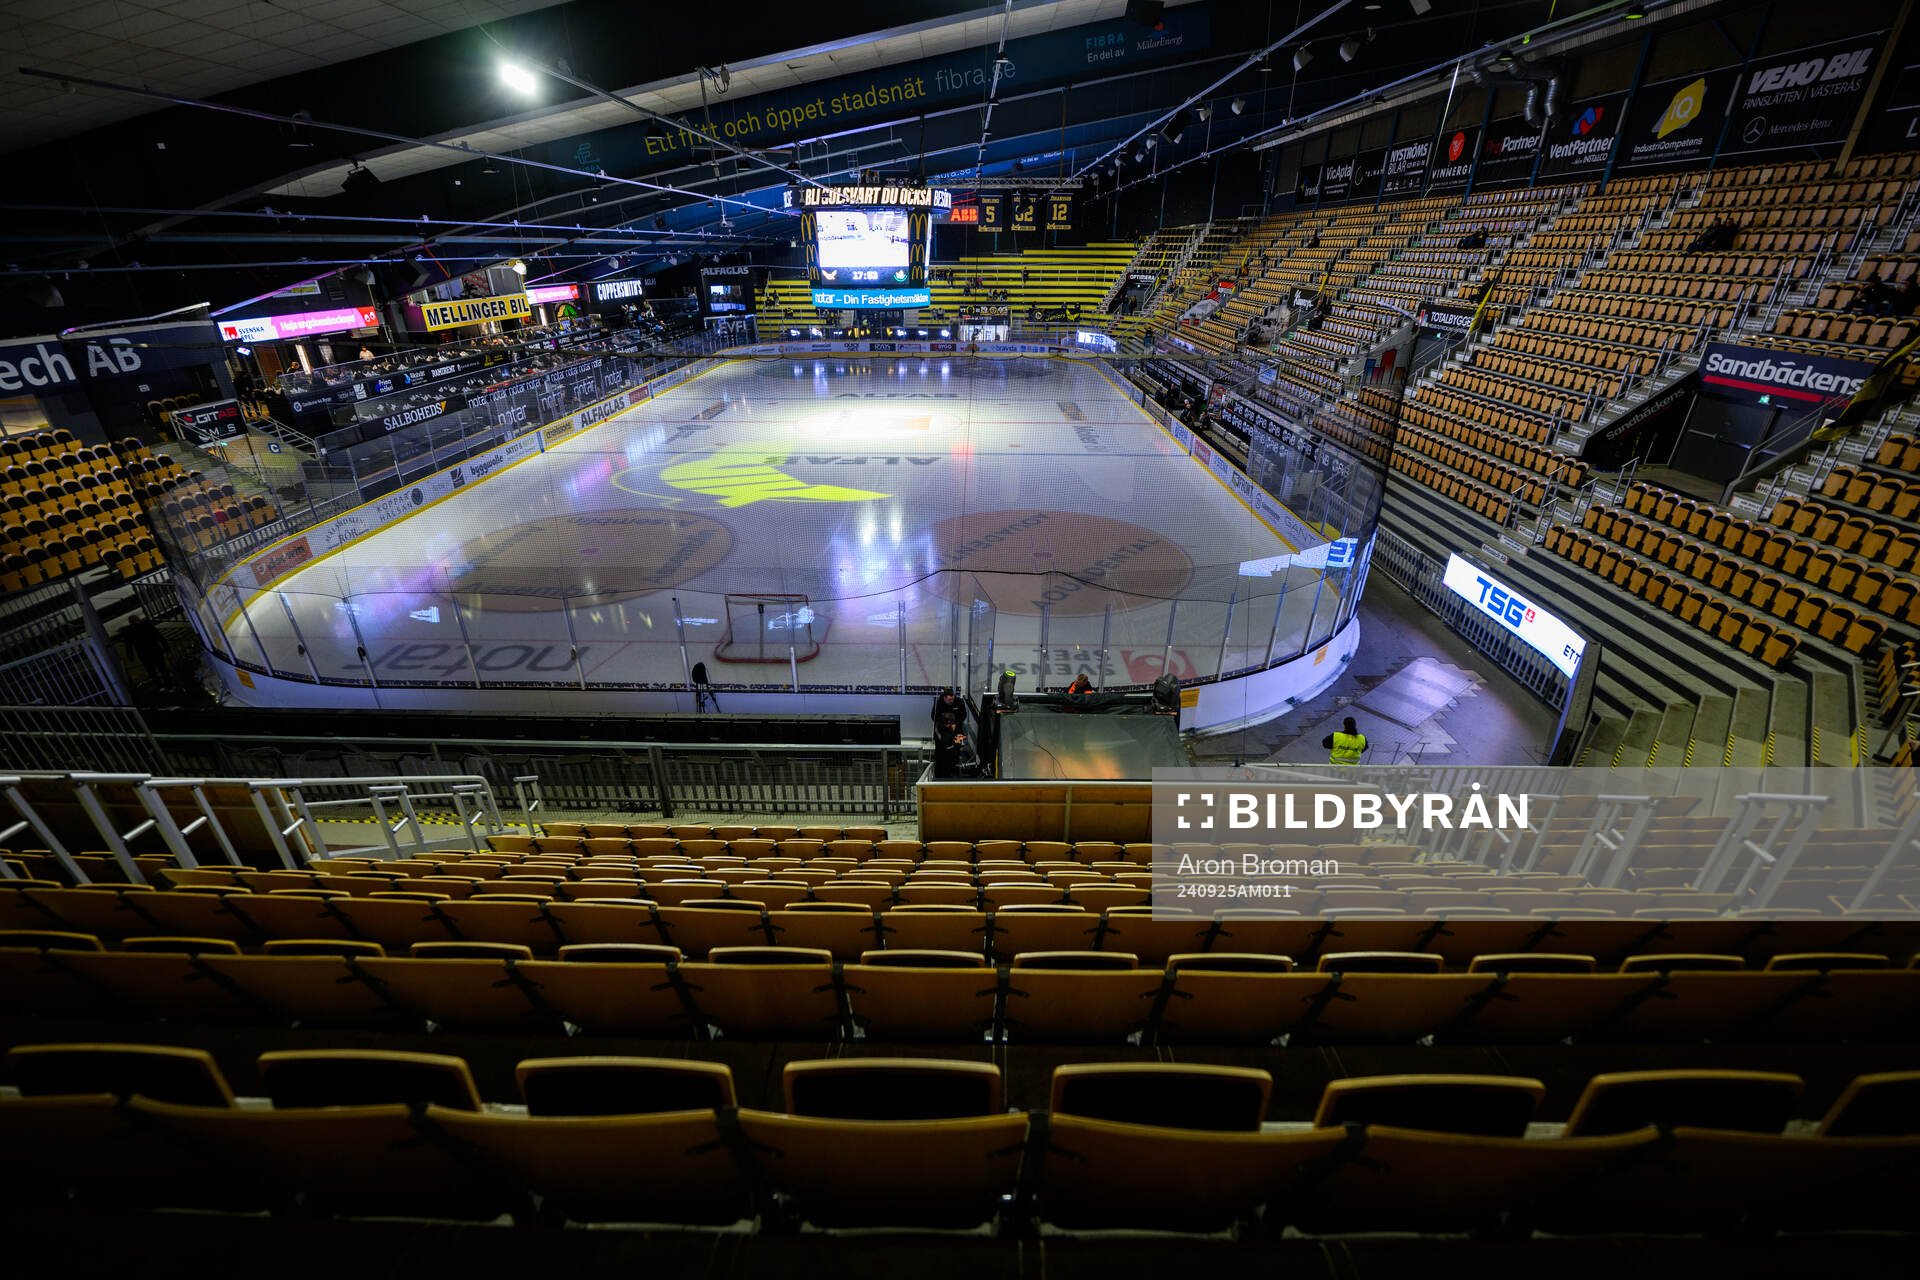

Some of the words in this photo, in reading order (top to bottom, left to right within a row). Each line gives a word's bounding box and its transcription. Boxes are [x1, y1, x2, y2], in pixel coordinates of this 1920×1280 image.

[1085, 31, 1126, 50] FIBRA
[1099, 49, 1113, 61] del
[1115, 49, 1125, 58] av
[935, 60, 1017, 93] fibra.se
[1747, 57, 1826, 95] VEHO
[1819, 47, 1874, 81] BIL
[1742, 89, 1803, 110] FINNSLÄTTEN
[1809, 78, 1863, 98] VÄSTERÅS
[644, 132, 677, 155] Ett
[678, 122, 721, 146] fritt
[723, 111, 761, 137] och
[765, 97, 828, 132] öppet
[830, 75, 927, 115] stadsnät
[1768, 118, 1833, 136] Mercedes-Benz
[1390, 142, 1429, 163] NYSTRÖMS
[1549, 136, 1615, 160] VentPartner
[1633, 136, 1704, 154] IndustriCompetens
[1431, 164, 1473, 179] VINNERGI
[805, 188, 820, 206] BLI
[881, 187, 899, 205] DU
[899, 184, 932, 206] OCKSÅ
[950, 208, 978, 222] ABB
[985, 205, 996, 223] 5
[1052, 203, 1067, 221] 12
[702, 266, 750, 276] ALFAGLAS
[597, 280, 643, 301] COPPERSMITH'S
[843, 294, 859, 305] Din
[426, 301, 507, 327] MELLINGER
[511, 298, 530, 314] BIL
[238, 326, 265, 335] SVENSKA
[87, 337, 142, 378] AB
[550, 369, 565, 382] notar
[604, 369, 623, 386] notar
[468, 394, 488, 409] notar
[489, 389, 508, 402] notar
[508, 383, 527, 396] notar
[526, 378, 542, 390] notar
[573, 379, 595, 396] notar
[384, 402, 443, 432] SALBOHEDS
[497, 404, 527, 425] notar
[581, 396, 626, 428] ALFAGLAS
[269, 443, 279, 453] C
[1476, 575, 1527, 628] TSG
[1032, 648, 1112, 661] SPEL
[961, 662, 1116, 676] SVENSKA
